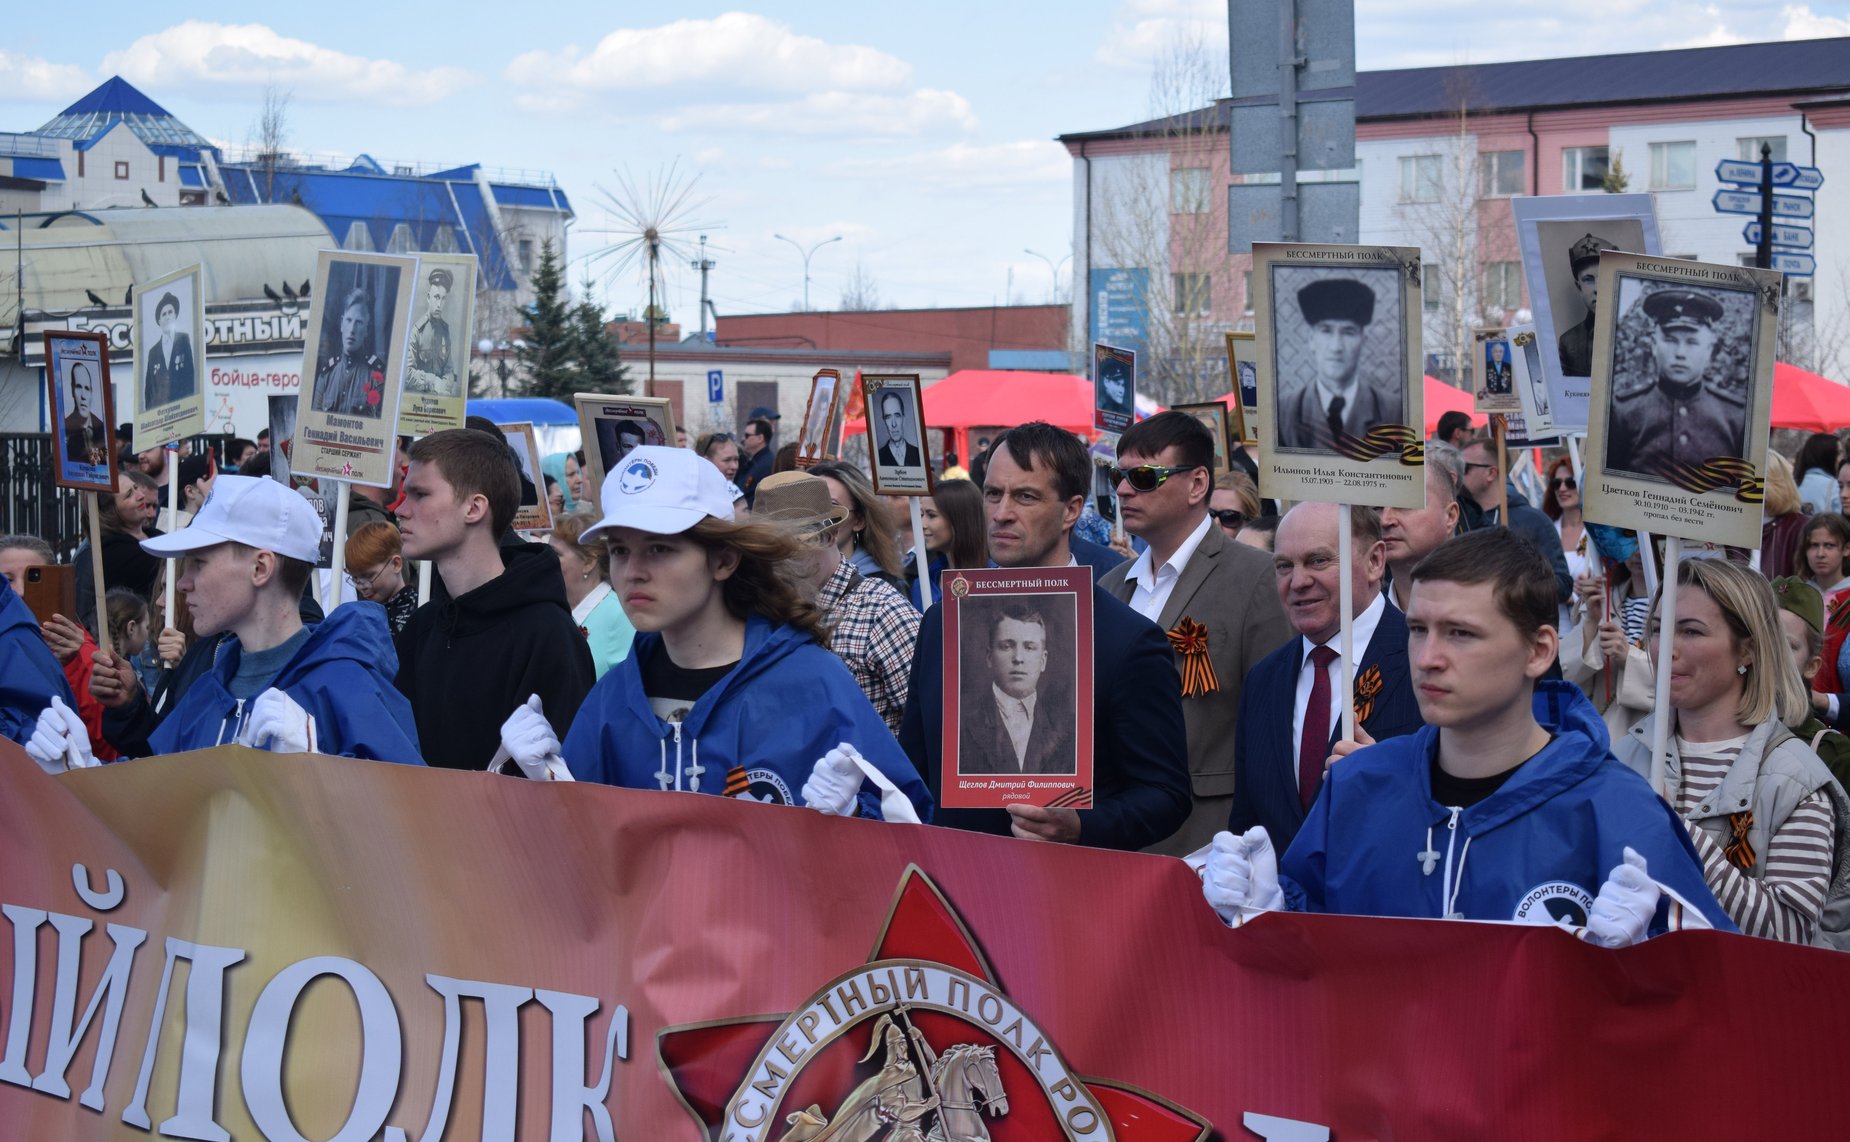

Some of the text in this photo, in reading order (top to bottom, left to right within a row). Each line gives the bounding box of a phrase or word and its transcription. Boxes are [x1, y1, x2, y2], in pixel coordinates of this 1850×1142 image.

[1783, 231, 1799, 242] БАНК
[1286, 250, 1383, 261] БЕССМЕРТНЫЙ ПОЛК
[1636, 261, 1740, 283] БЕССМЕРТНЫЙ ПОЛК
[211, 368, 300, 391] бойца-геро
[326, 414, 364, 430] Мамонтов
[304, 426, 384, 448] Геннадий Васильевич
[341, 449, 362, 459] СЕРЖАНТ
[1273, 465, 1412, 481] Ильинов Илья Константинович
[1343, 479, 1378, 488] 22.08.1975
[1602, 483, 1743, 514] Цветков Геннадий Семёнович
[1634, 499, 1669, 511] 30.10.1910
[1678, 506, 1705, 517] 03.1942
[1643, 511, 1704, 526] пропал без вести
[976, 578, 1069, 589] БЕССМЕРТНЫЙ ПОЛК
[959, 780, 1075, 790] Щеглов Дмитрий Филиппович
[1002, 791, 1031, 801] рядовой
[1517, 885, 1580, 919] ВОЛОНТЕРЫ
[947, 975, 1052, 1071] ПОЛК
[122, 936, 629, 1142] ПОЛК
